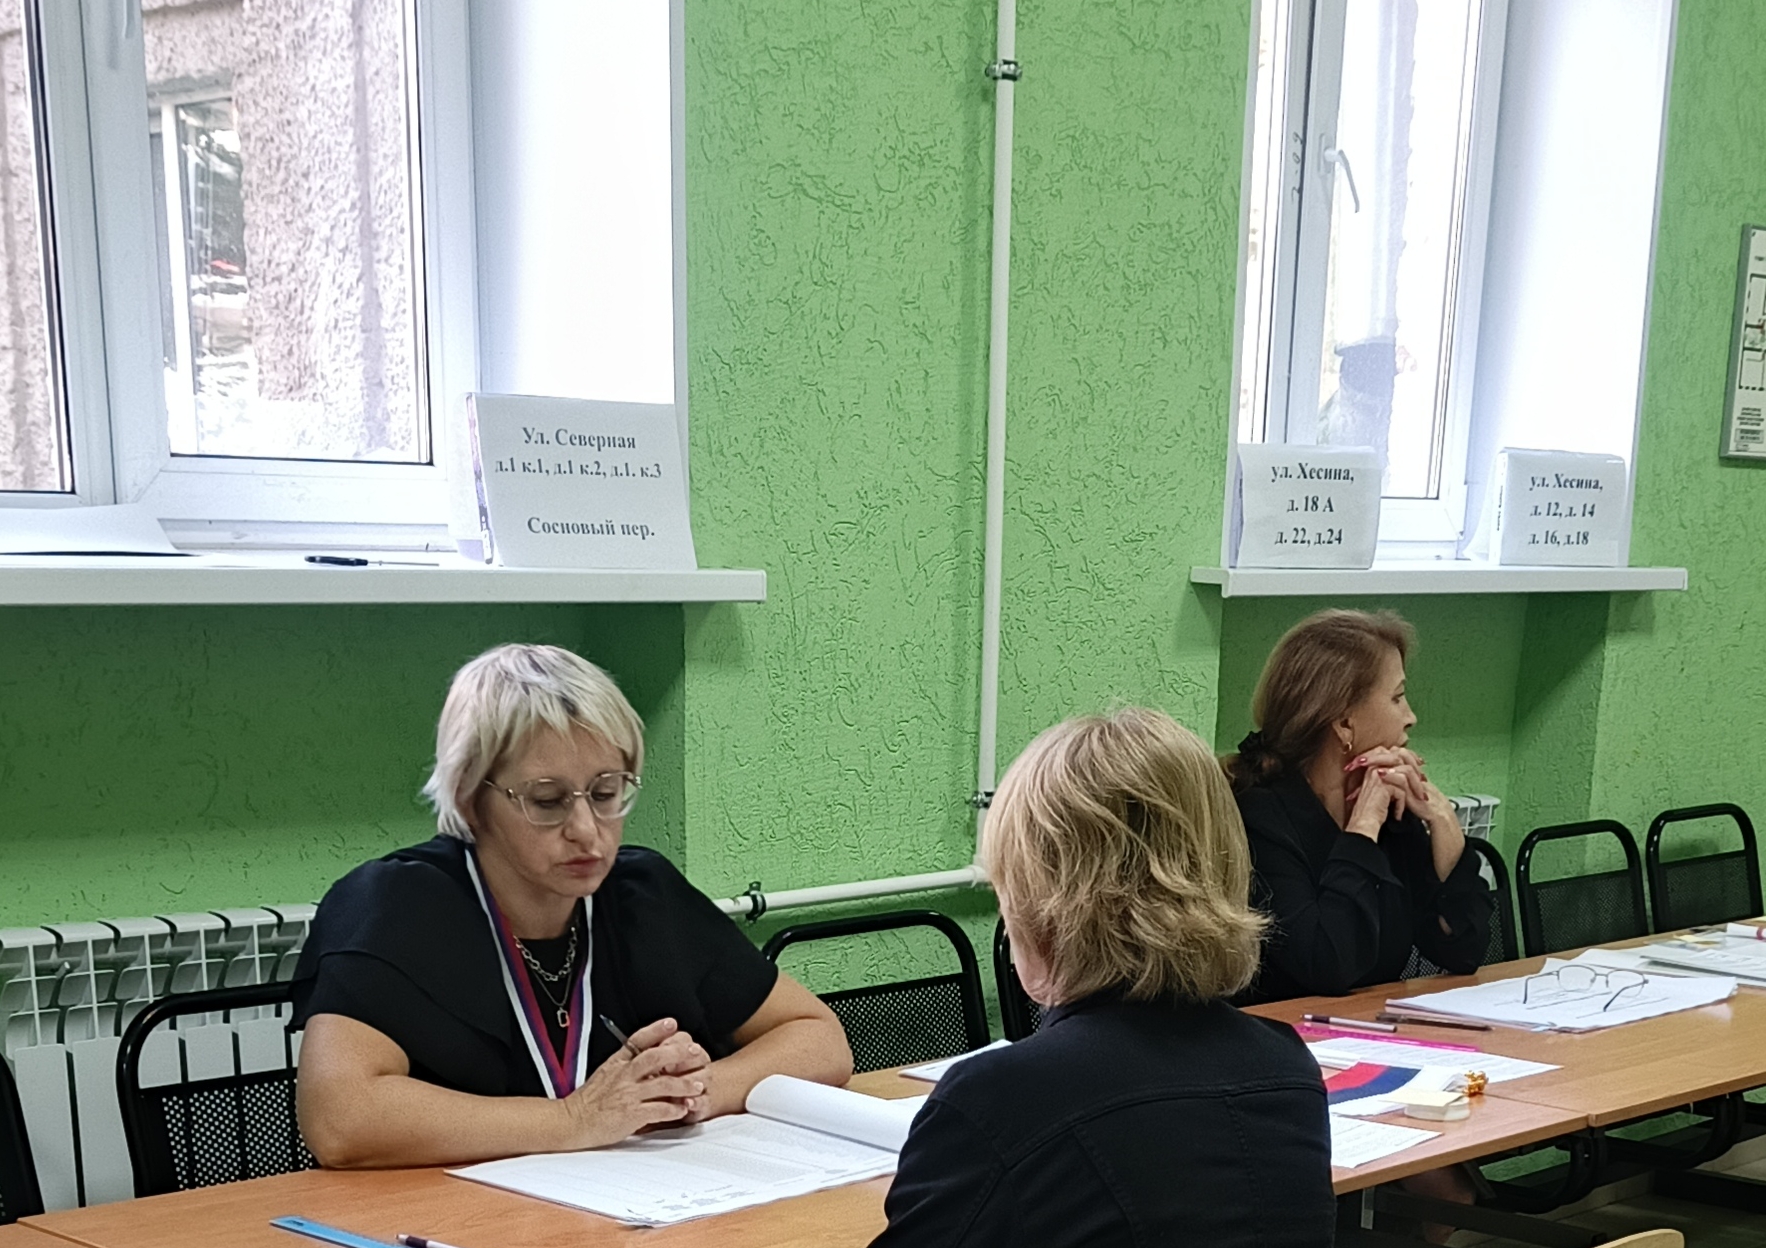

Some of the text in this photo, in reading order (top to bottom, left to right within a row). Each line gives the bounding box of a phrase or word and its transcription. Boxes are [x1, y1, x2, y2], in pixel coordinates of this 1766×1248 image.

[521, 426, 636, 452] Ул. Северная
[494, 457, 516, 473] д.1
[521, 458, 550, 476] к.1,
[553, 460, 573, 476] д.1
[579, 460, 607, 479] к.2,
[640, 463, 662, 479] к.3
[1271, 462, 1355, 484] ул. Хесина,
[1529, 473, 1603, 492] ул. Хесина,
[1287, 499, 1298, 512] д.
[1304, 495, 1319, 512] 18
[1546, 502, 1562, 518] 12,
[1582, 503, 1595, 517] 14
[526, 516, 656, 541] Сосновый пер.
[1275, 527, 1343, 547] д. 22, д.24
[1544, 530, 1560, 546] 16,
[1563, 531, 1589, 546] д.18
